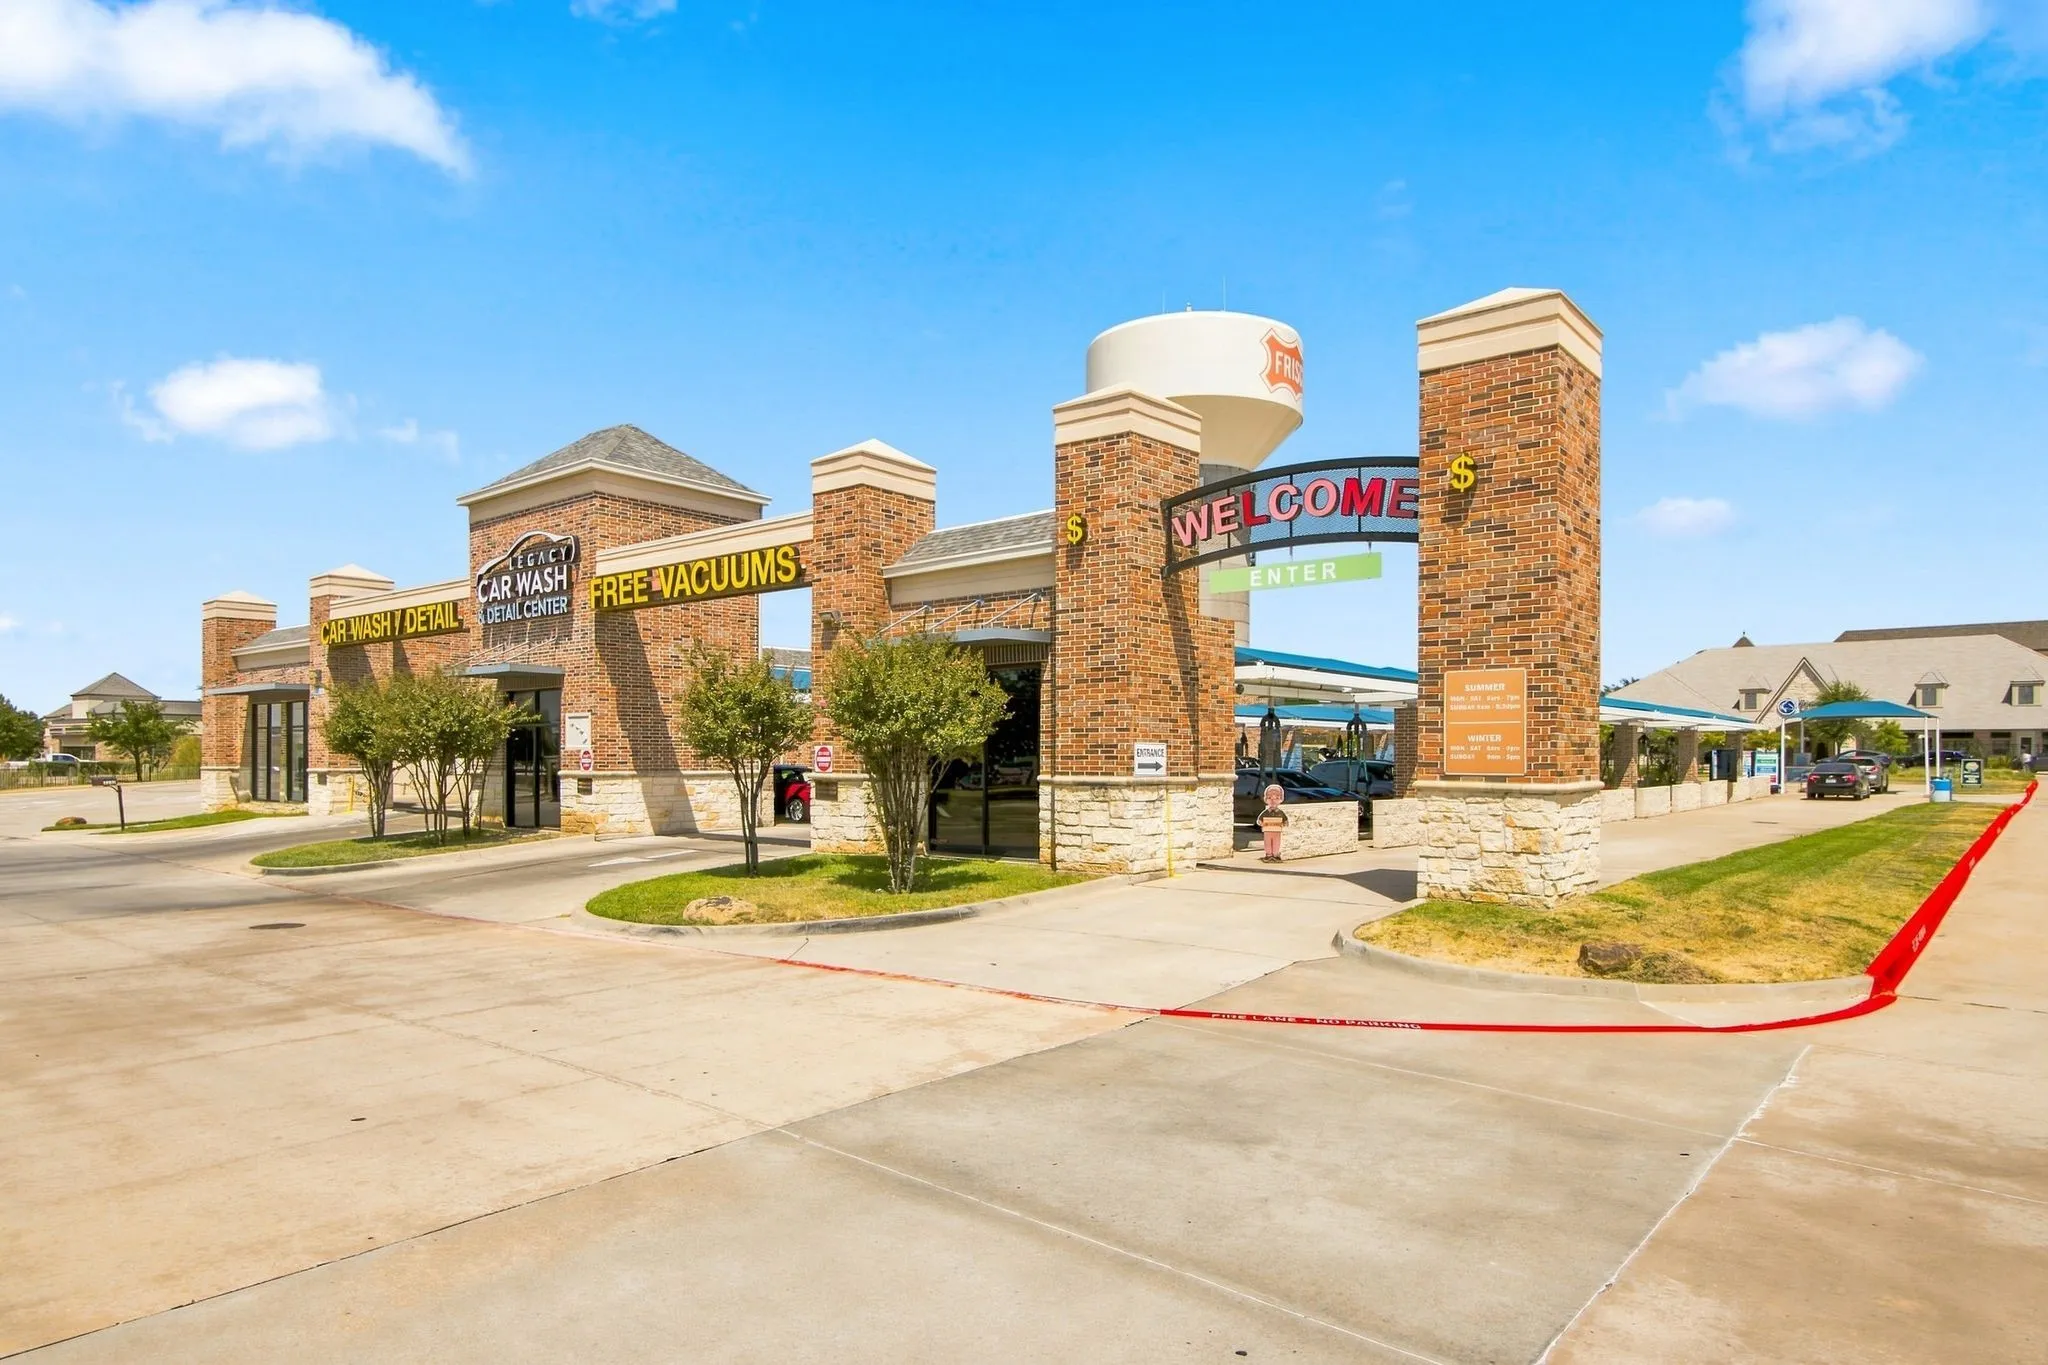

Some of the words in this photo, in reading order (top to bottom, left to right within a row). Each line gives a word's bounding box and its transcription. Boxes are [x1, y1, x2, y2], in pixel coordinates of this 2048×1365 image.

[1450, 453, 1474, 493] $
[1172, 476, 1419, 548] WELCOME
[1066, 514, 1083, 544] $
[508, 545, 567, 571] LEGACY
[478, 575, 512, 603] CAR
[516, 564, 567, 597] WASH
[589, 570, 648, 609] FREE
[657, 545, 796, 599] VACUUMS
[1249, 562, 1336, 587] ENTER
[320, 619, 347, 645] CAR
[351, 611, 391, 641] WASH
[405, 601, 459, 634] DETAIL
[487, 601, 522, 624] DETAIL
[524, 595, 568, 618] CENTER
[1464, 683, 1506, 692] SUMMER
[1467, 734, 1502, 742] WINTER
[1136, 748, 1165, 758] ENTRANCE
[1252, 1015, 1298, 1023] LANE
[1345, 1020, 1422, 1030] PARKING
